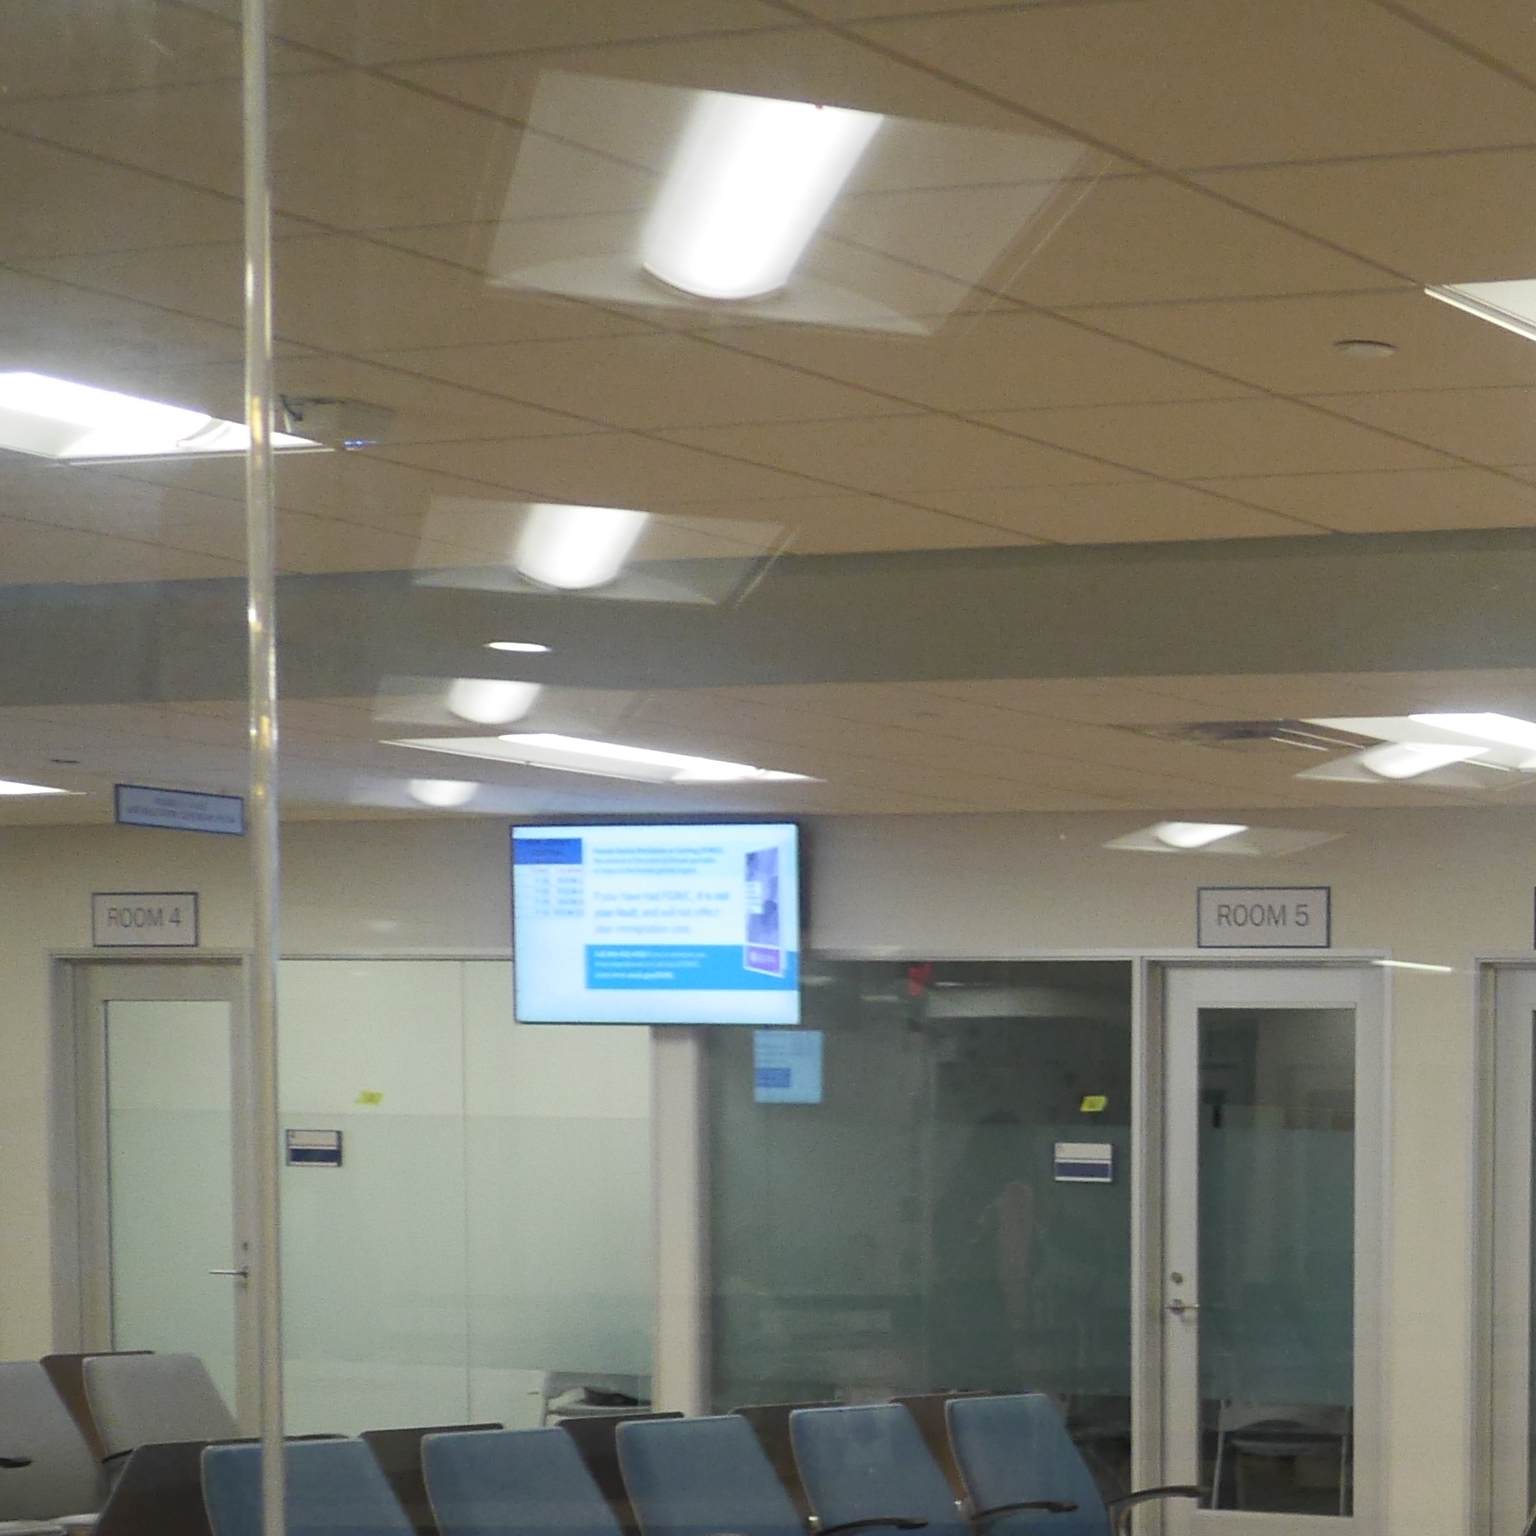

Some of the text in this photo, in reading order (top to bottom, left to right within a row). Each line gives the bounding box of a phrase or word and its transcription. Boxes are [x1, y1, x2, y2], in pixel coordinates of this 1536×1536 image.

[107, 907, 182, 928] ROOM 4
[1216, 903, 1310, 927] ROOM 5
